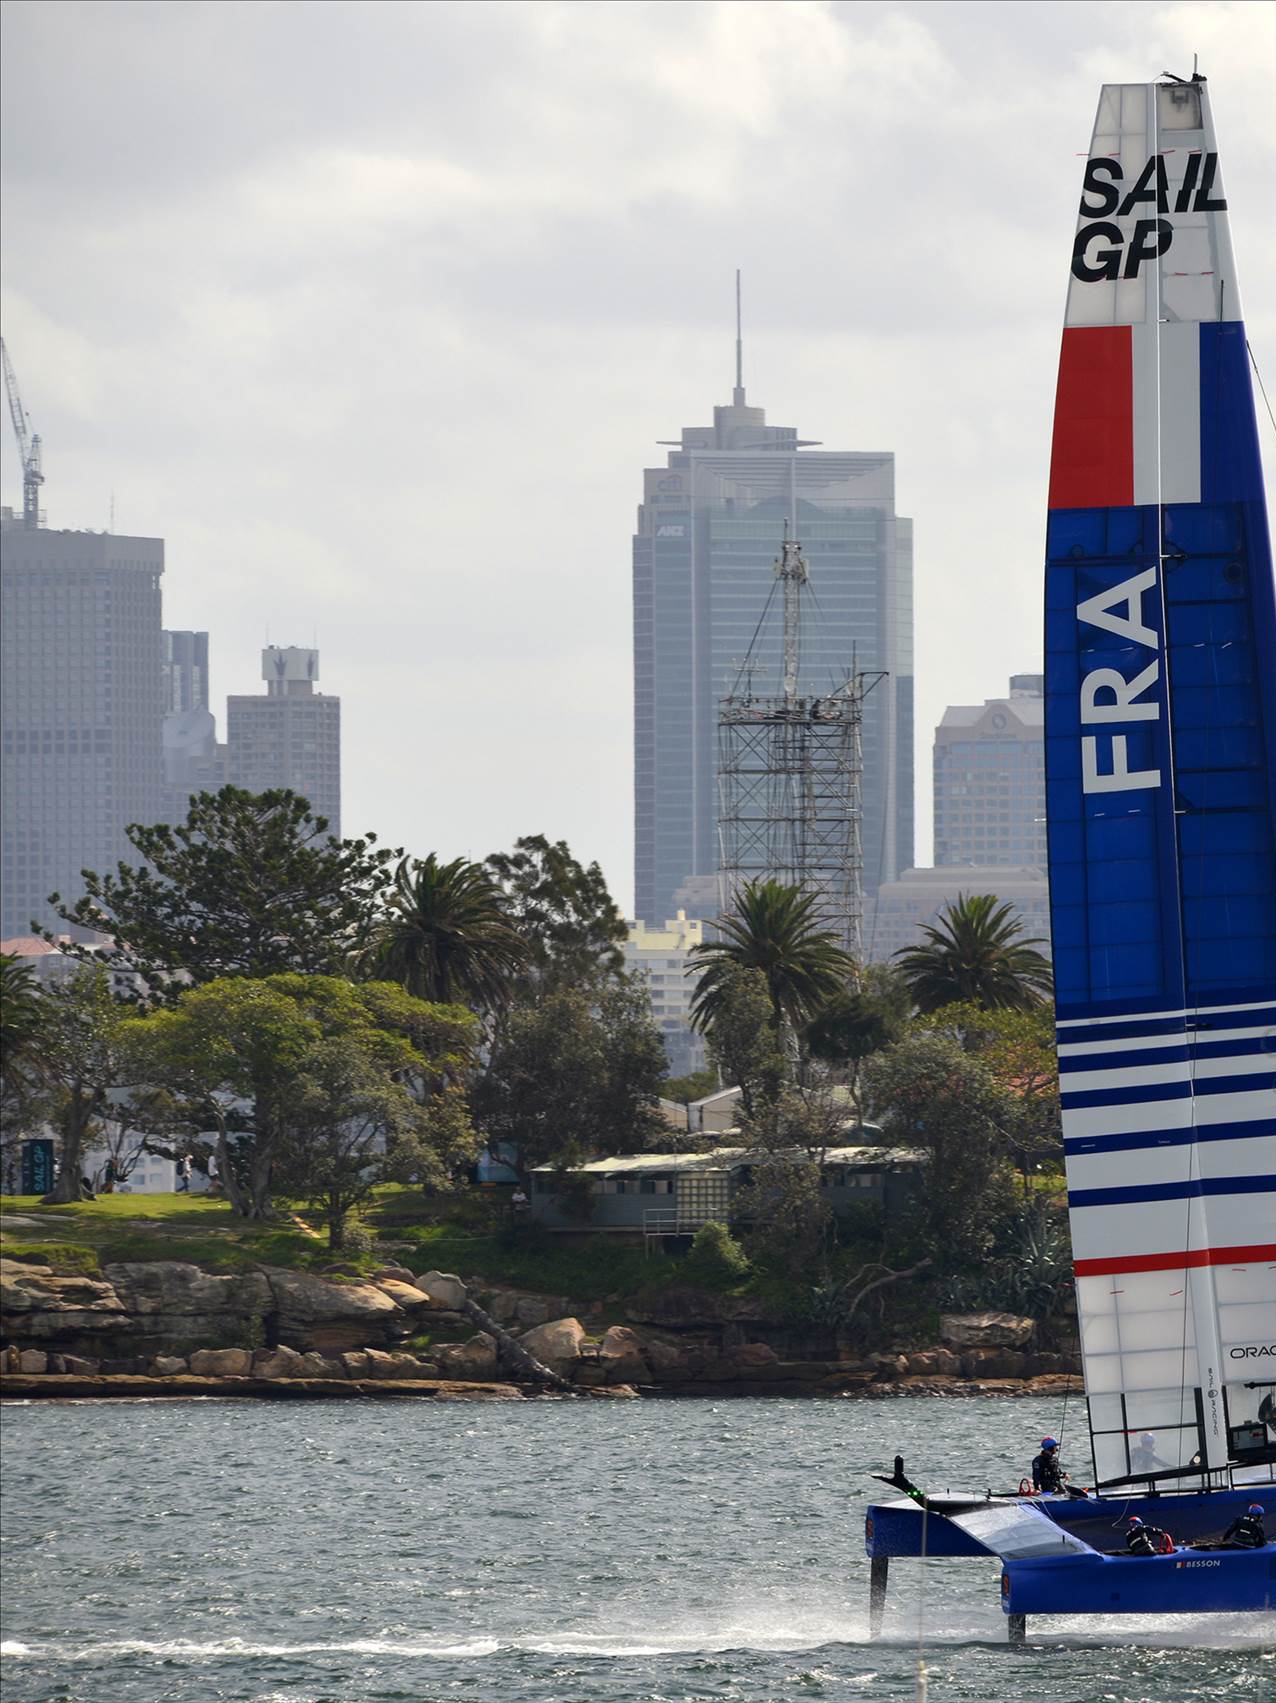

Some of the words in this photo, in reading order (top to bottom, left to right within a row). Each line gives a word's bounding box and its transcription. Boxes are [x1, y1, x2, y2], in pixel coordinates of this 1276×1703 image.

[1078, 152, 1228, 219] SAIL
[1071, 218, 1174, 283] GP
[1076, 565, 1161, 794] FRA
[1186, 1559, 1221, 1568] BESSON
